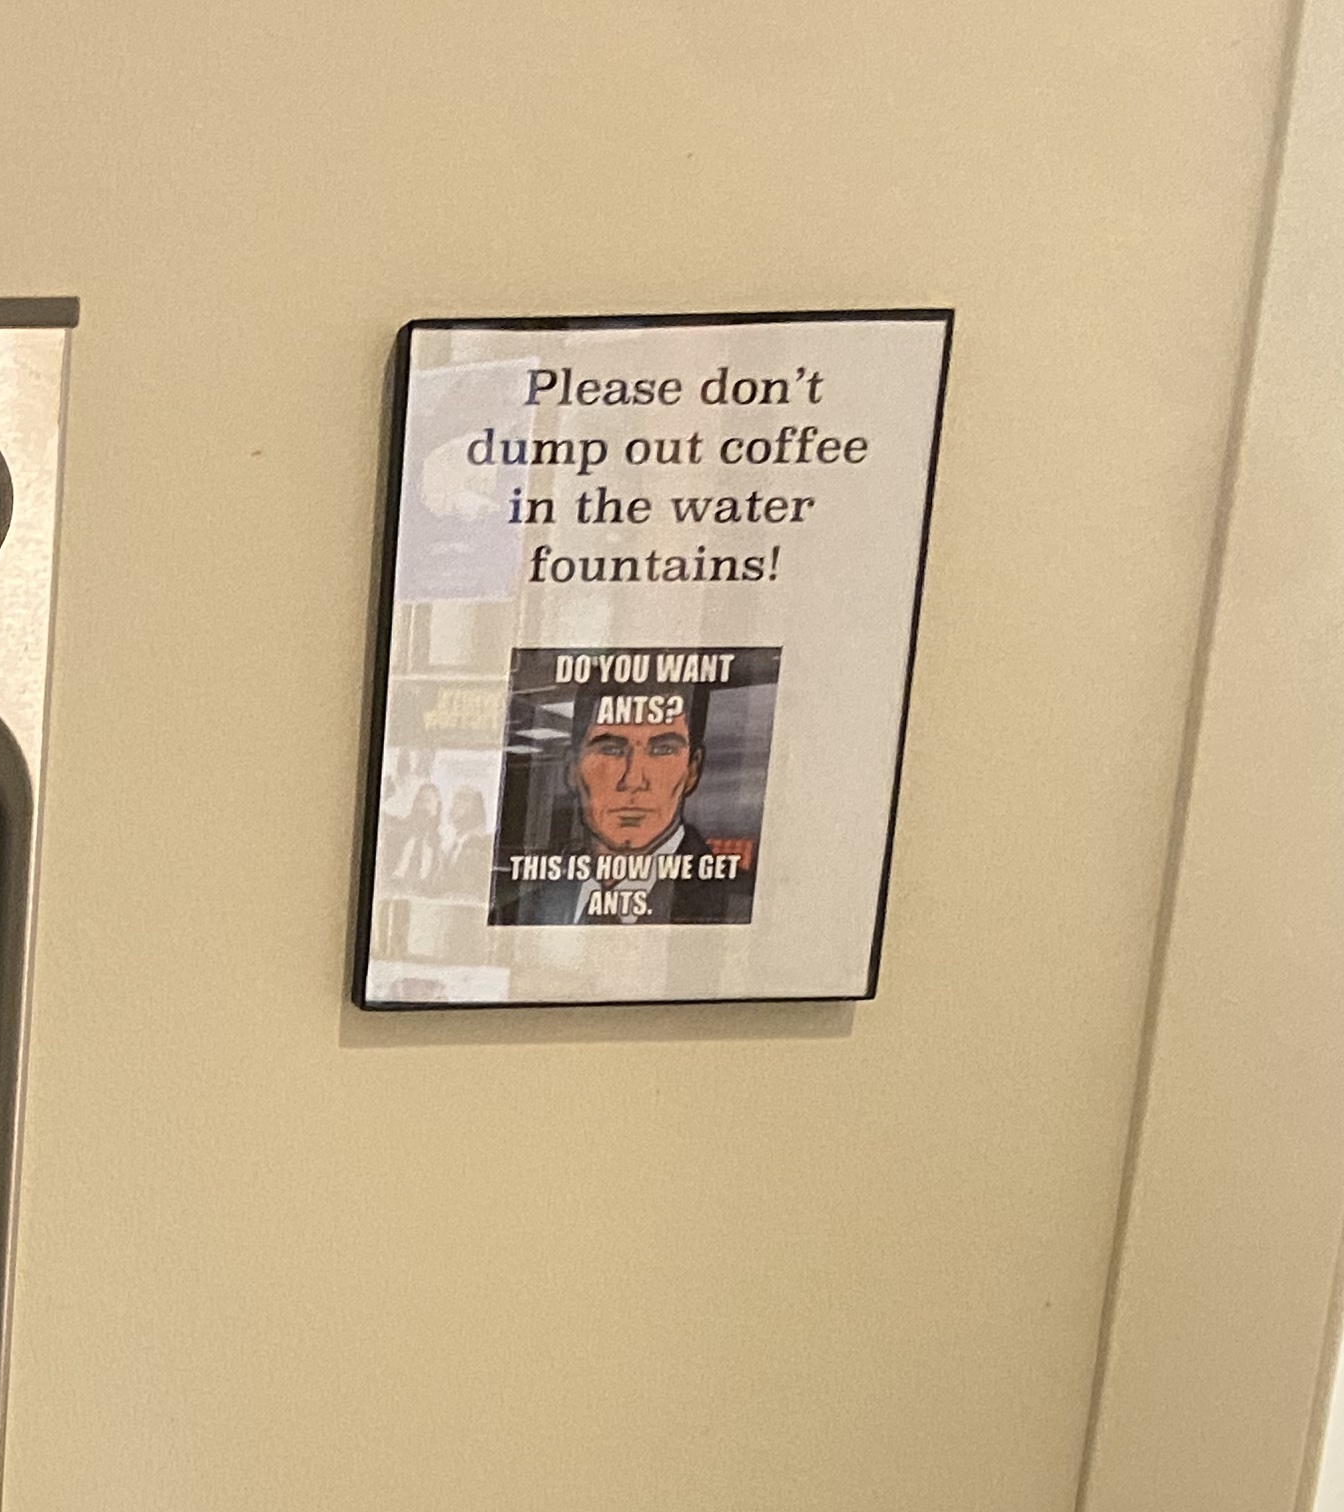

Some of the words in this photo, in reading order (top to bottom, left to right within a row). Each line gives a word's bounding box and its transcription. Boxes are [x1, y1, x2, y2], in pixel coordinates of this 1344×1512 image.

[523, 368, 682, 408] Please
[700, 366, 824, 407] don't
[466, 428, 608, 476] dump
[624, 433, 704, 465] out
[720, 426, 869, 465] coffee
[508, 487, 555, 524] in
[576, 487, 652, 524] the
[672, 491, 815, 524] water
[528, 545, 781, 584] fountains!
[555, 654, 591, 684] DO
[598, 654, 653, 684] YOU
[657, 654, 735, 684] WANT
[597, 695, 684, 726] ANTS?
[510, 855, 563, 881] THIS
[567, 855, 590, 881] IS
[596, 855, 653, 881] HOW
[657, 855, 693, 880] WE
[698, 854, 741, 880] GET
[587, 889, 653, 917] ANTS.
